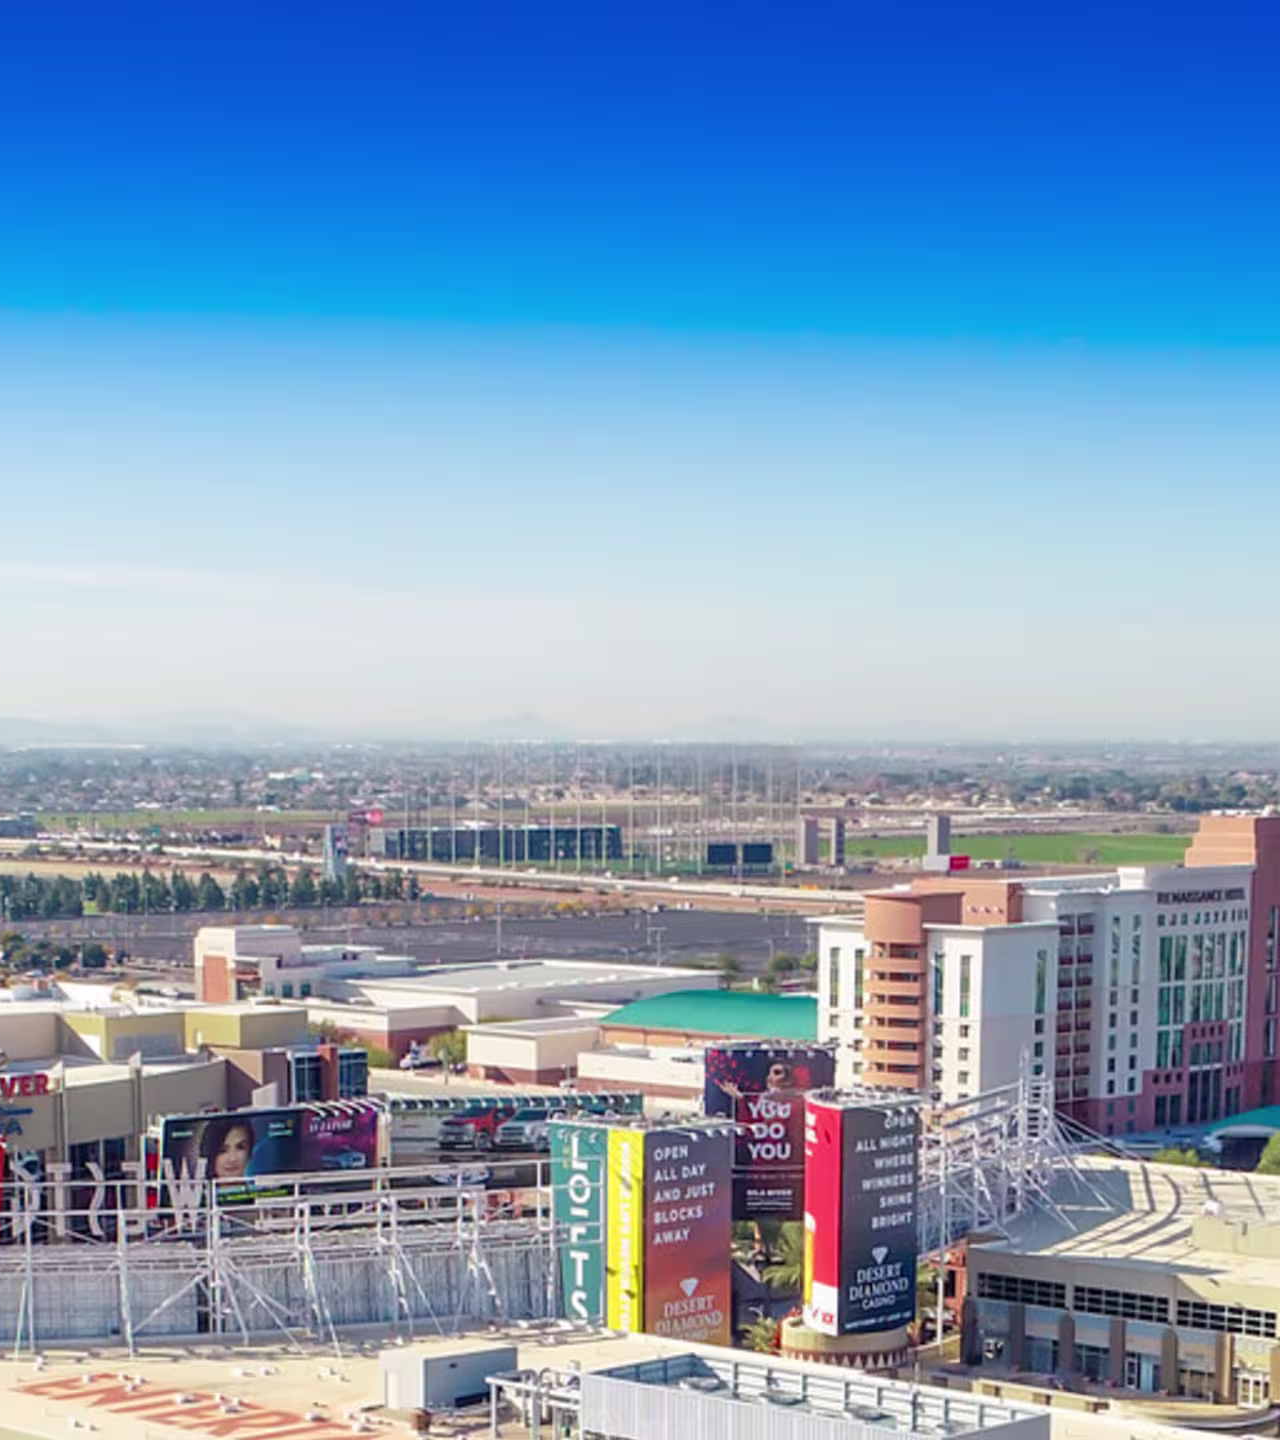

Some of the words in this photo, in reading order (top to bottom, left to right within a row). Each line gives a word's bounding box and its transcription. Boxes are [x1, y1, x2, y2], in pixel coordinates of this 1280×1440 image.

[748, 1101, 791, 1119] YOU
[884, 1115, 915, 1129] OPEN
[752, 1124, 785, 1139] DO
[748, 1143, 791, 1160] YOU
[855, 1139, 877, 1153] ALL
[880, 1134, 915, 1150] NIGHT
[653, 1145, 689, 1161] OPEN
[874, 1152, 914, 1170] WHERE
[653, 1167, 679, 1182] ALL
[682, 1164, 706, 1179] DAY
[862, 1173, 914, 1191] WINNERS
[653, 1188, 681, 1203] AND
[684, 1183, 715, 1199] JUST
[879, 1193, 913, 1209] SHINE
[653, 1206, 704, 1224] BLOCKS
[871, 1212, 913, 1230] BRIGHT
[652, 1229, 691, 1245] AWAY
[856, 1263, 903, 1283] DESERT
[849, 1277, 910, 1301] DIAMOND
[664, 1296, 715, 1318] DESERT
[862, 1295, 896, 1310] CASINO
[656, 1312, 723, 1333] DIAMOND
